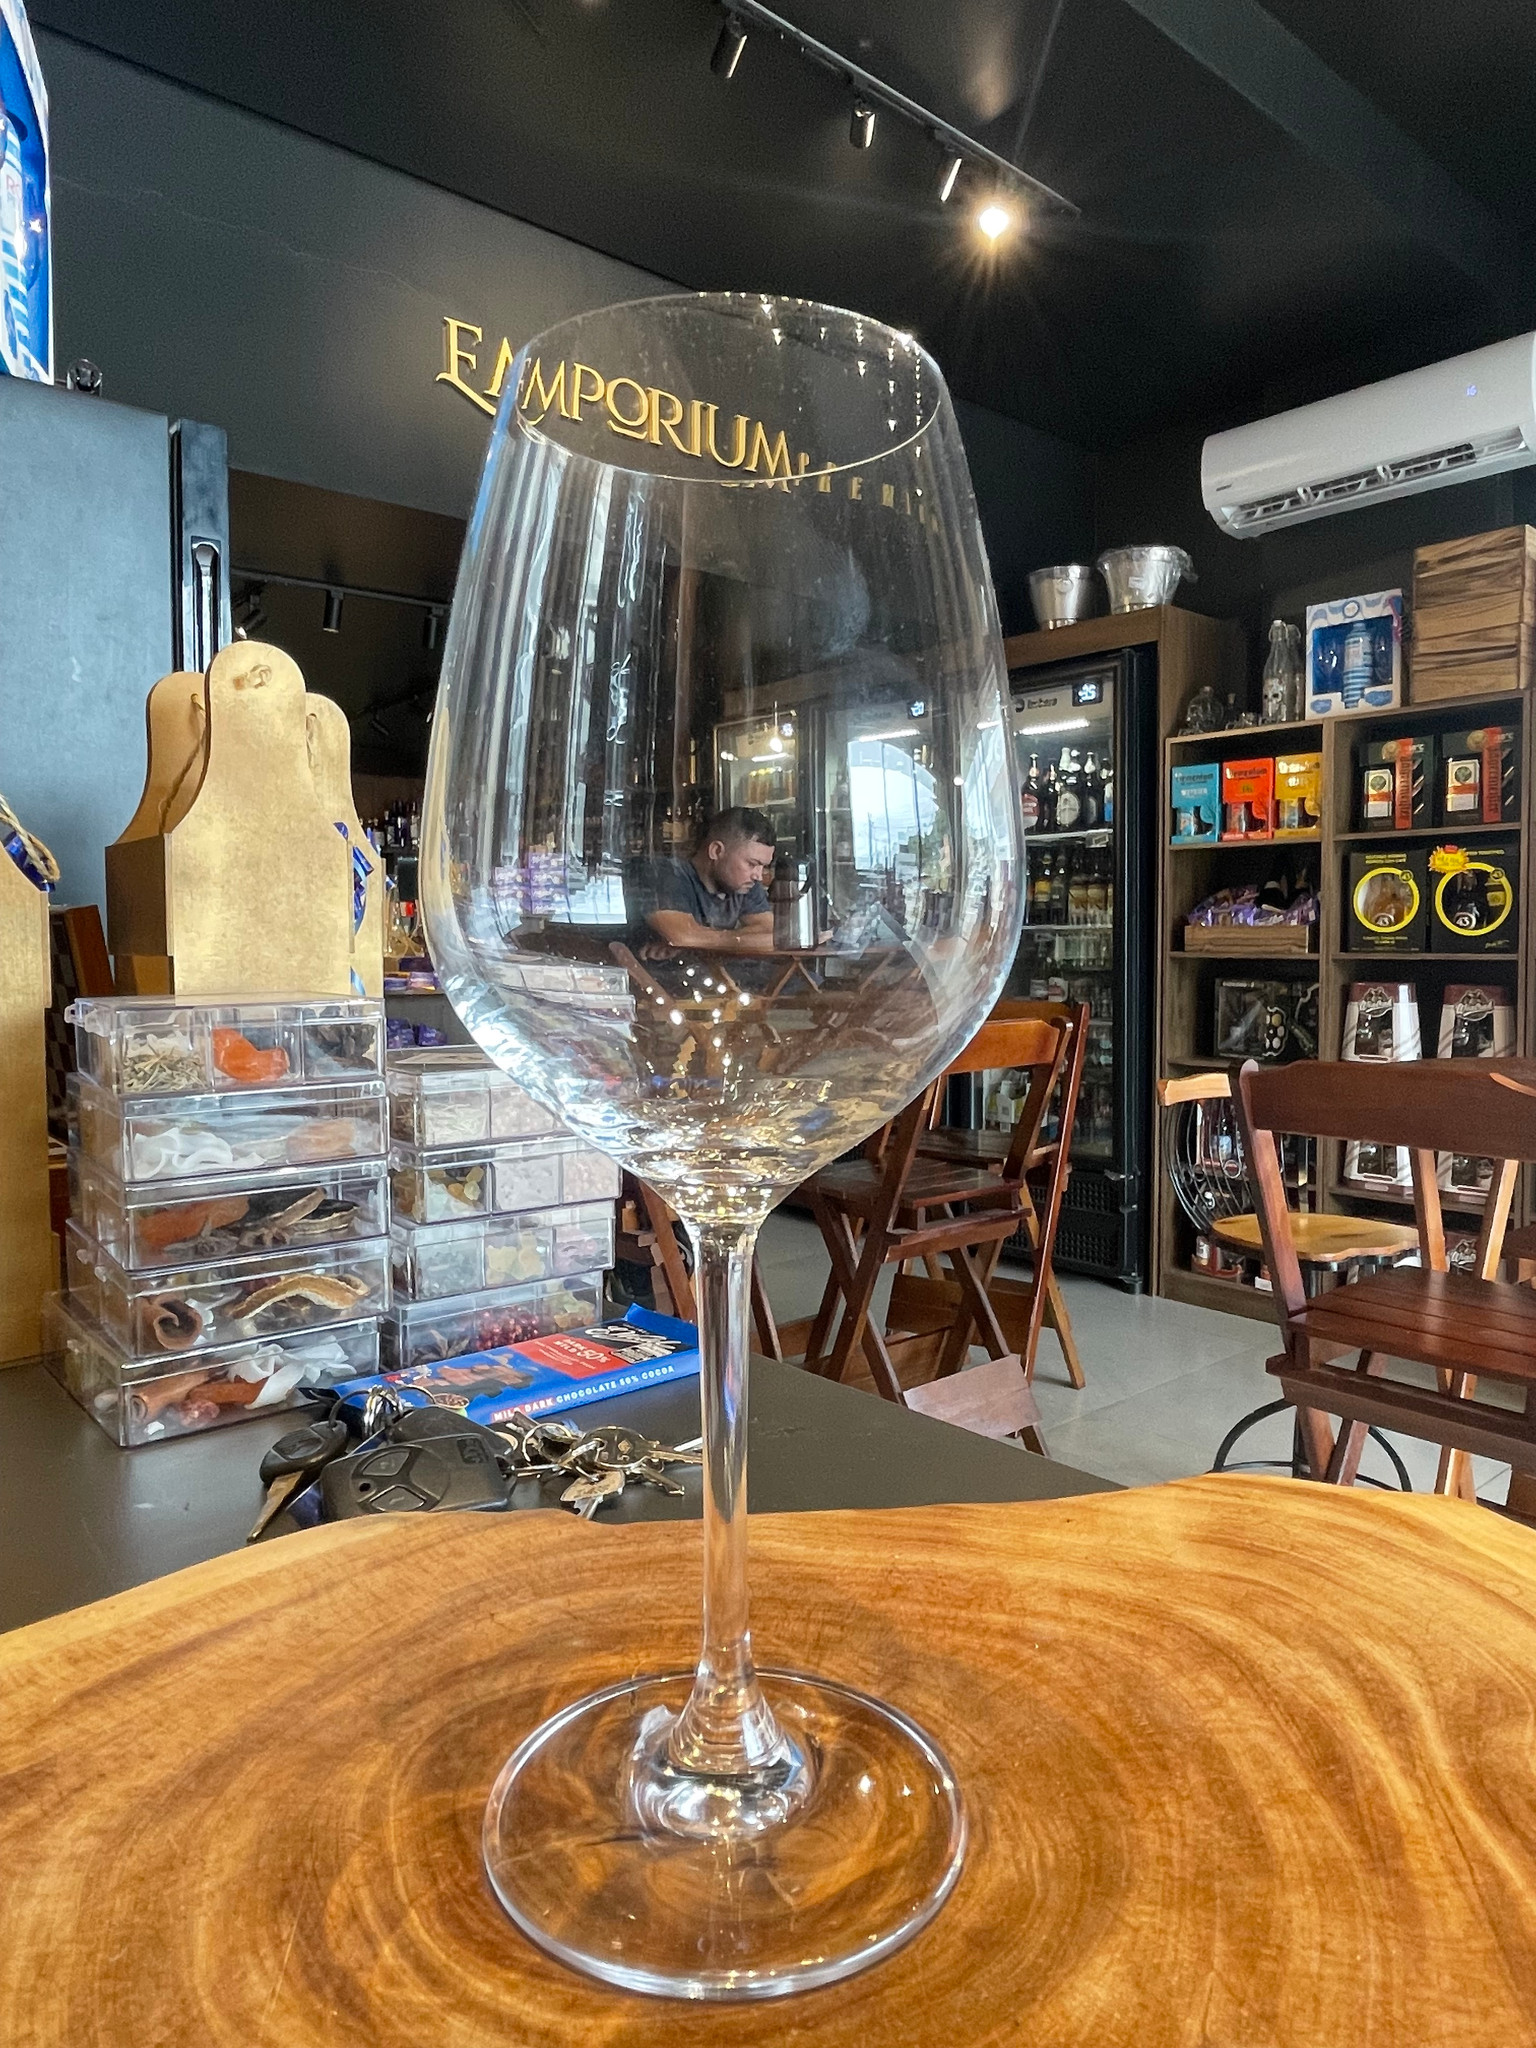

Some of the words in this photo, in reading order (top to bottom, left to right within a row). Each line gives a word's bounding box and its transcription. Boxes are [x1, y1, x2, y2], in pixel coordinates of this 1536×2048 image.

[524, 1397, 556, 1413] DARK
[556, 1380, 617, 1404] CHOCOLATE
[642, 1365, 675, 1380] COCOA
